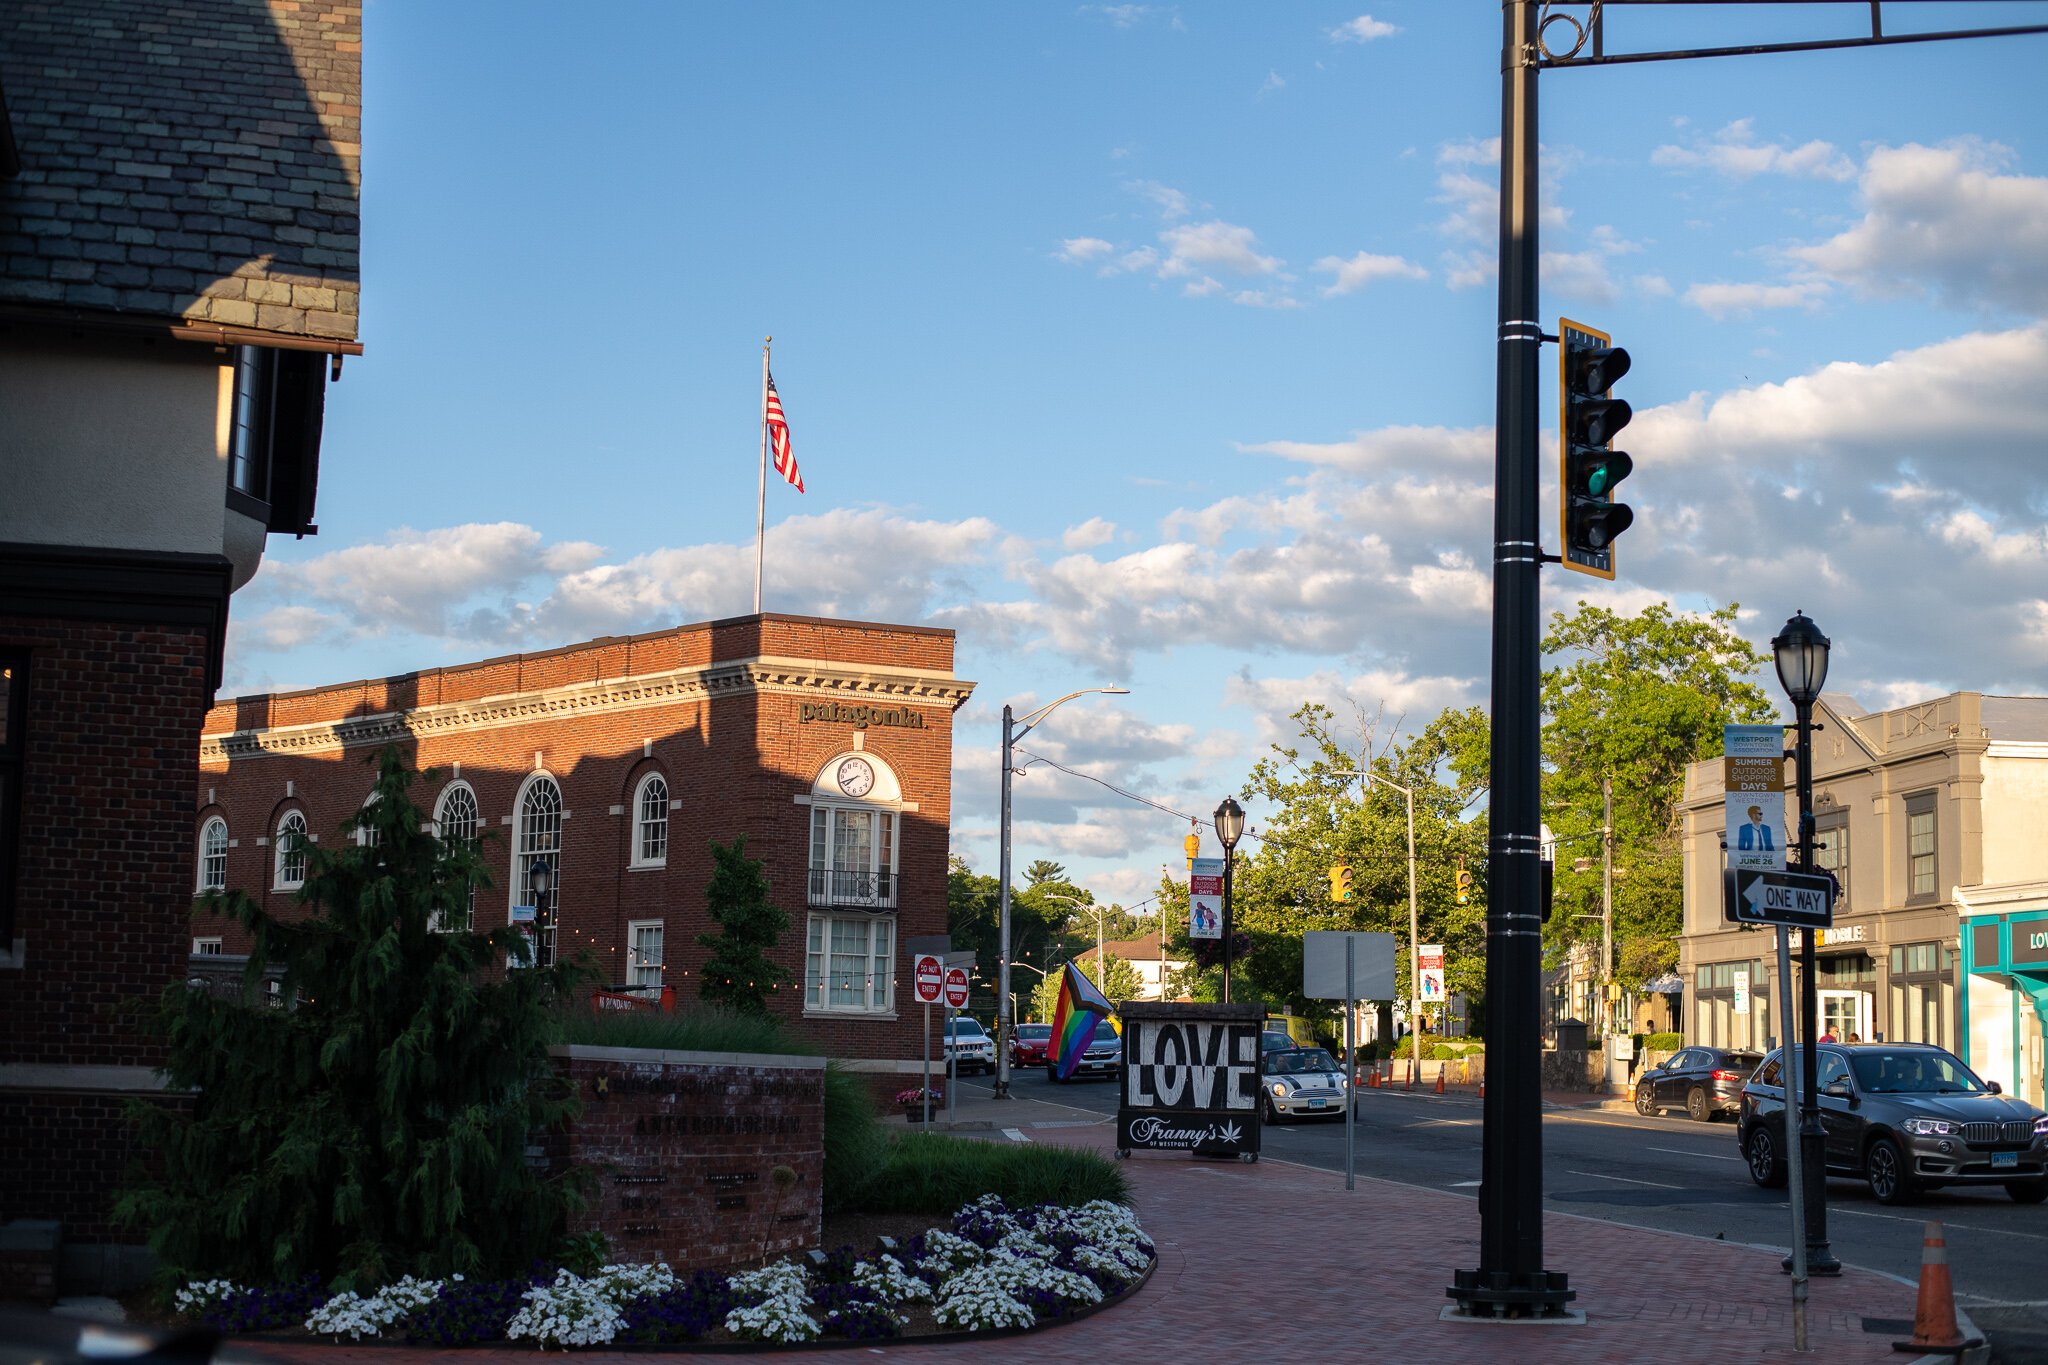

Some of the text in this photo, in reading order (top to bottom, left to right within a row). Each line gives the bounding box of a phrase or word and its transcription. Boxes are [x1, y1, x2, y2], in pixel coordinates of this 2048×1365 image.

[1735, 758, 1773, 766] SUMMER
[1731, 767, 1777, 775] OUTDOOR
[1731, 774, 1777, 782] SHOPPING
[1740, 782, 1767, 791] DAYS
[1766, 887, 1822, 911] ONE WAY
[1824, 925, 1864, 945] NOBLE
[928, 965, 938, 973] NOT
[956, 976, 964, 984] NOT
[921, 985, 937, 993] ENTER
[950, 993, 963, 1001] ENTER
[1128, 1023, 1257, 1110] LOVE
[1129, 1116, 1216, 1148] Franny's
